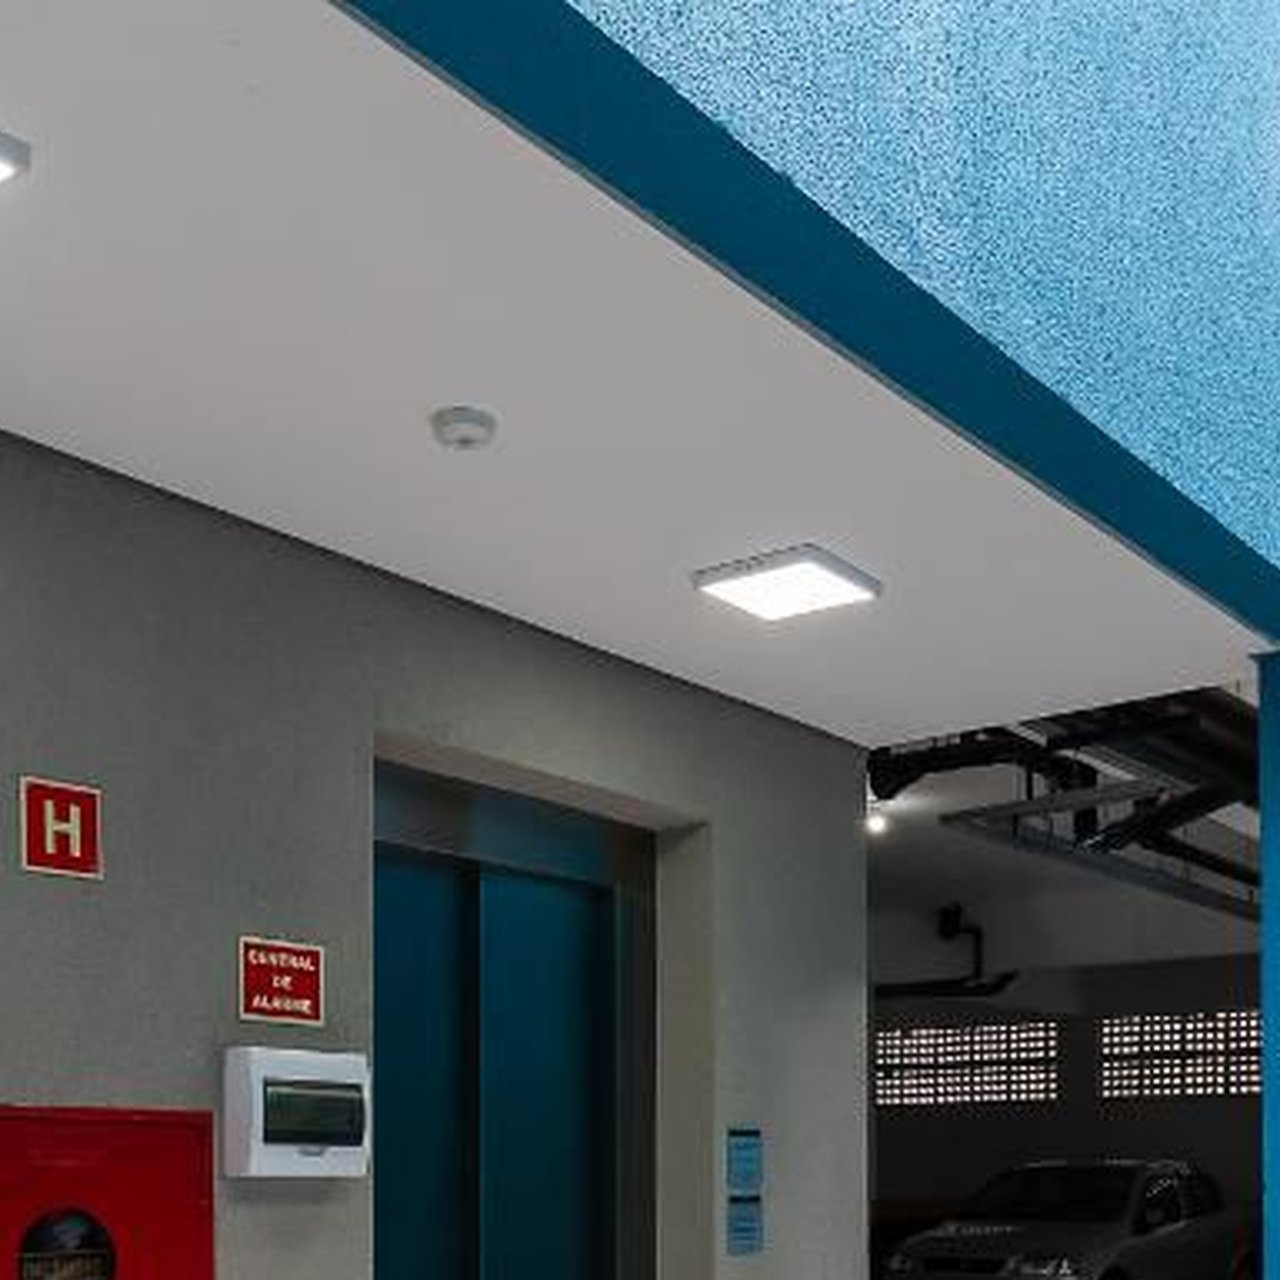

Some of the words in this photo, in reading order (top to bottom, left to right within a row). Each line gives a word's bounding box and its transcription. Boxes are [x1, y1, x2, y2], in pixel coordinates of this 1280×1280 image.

[44, 799, 81, 858] H
[248, 949, 316, 971] CENTRAL
[272, 975, 294, 991] DE
[251, 995, 312, 1014] ALARME
